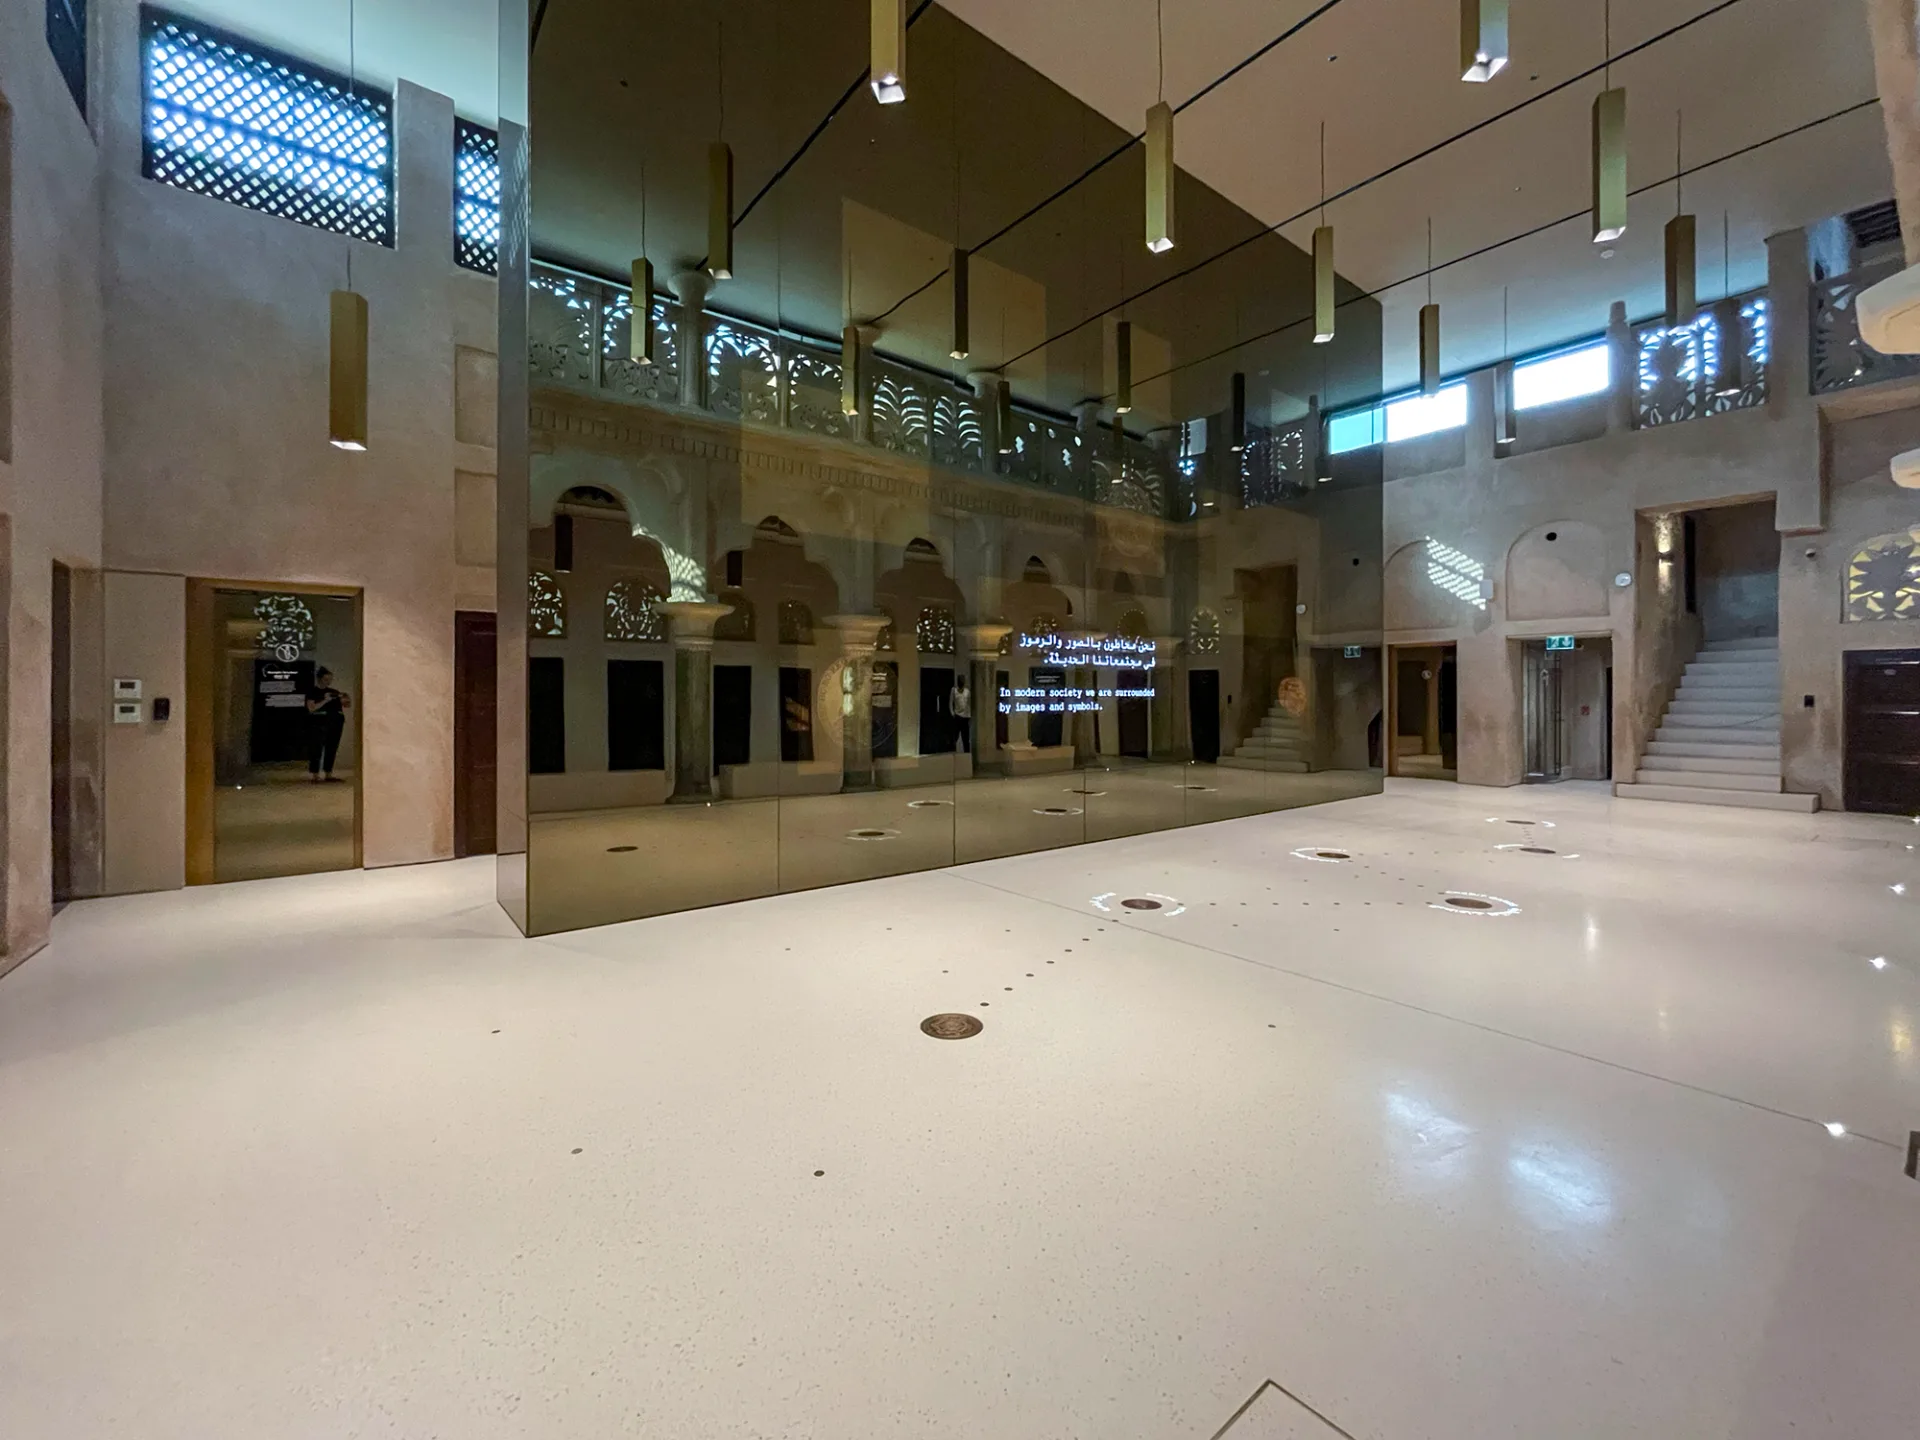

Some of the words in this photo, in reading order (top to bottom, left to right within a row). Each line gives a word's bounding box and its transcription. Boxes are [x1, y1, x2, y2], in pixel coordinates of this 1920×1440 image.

[1019, 632, 1062, 649] والرموز
[1065, 636, 1101, 651] بالصور
[1103, 638, 1137, 651] محاطون
[1138, 641, 1156, 653] نحن
[1092, 654, 1142, 669] مجتمعاتنا
[1143, 656, 1156, 670] في
[1000, 687, 1011, 697] In
[1014, 687, 1046, 697] modern
[1049, 687, 1083, 699] society
[1085, 688, 1096, 697] we
[1098, 688, 1112, 697] are
[1114, 688, 1156, 697] surrounded
[999, 702, 1012, 714] by
[1015, 702, 1046, 714] images
[1049, 702, 1065, 711] and
[1068, 701, 1103, 713] symbols.
